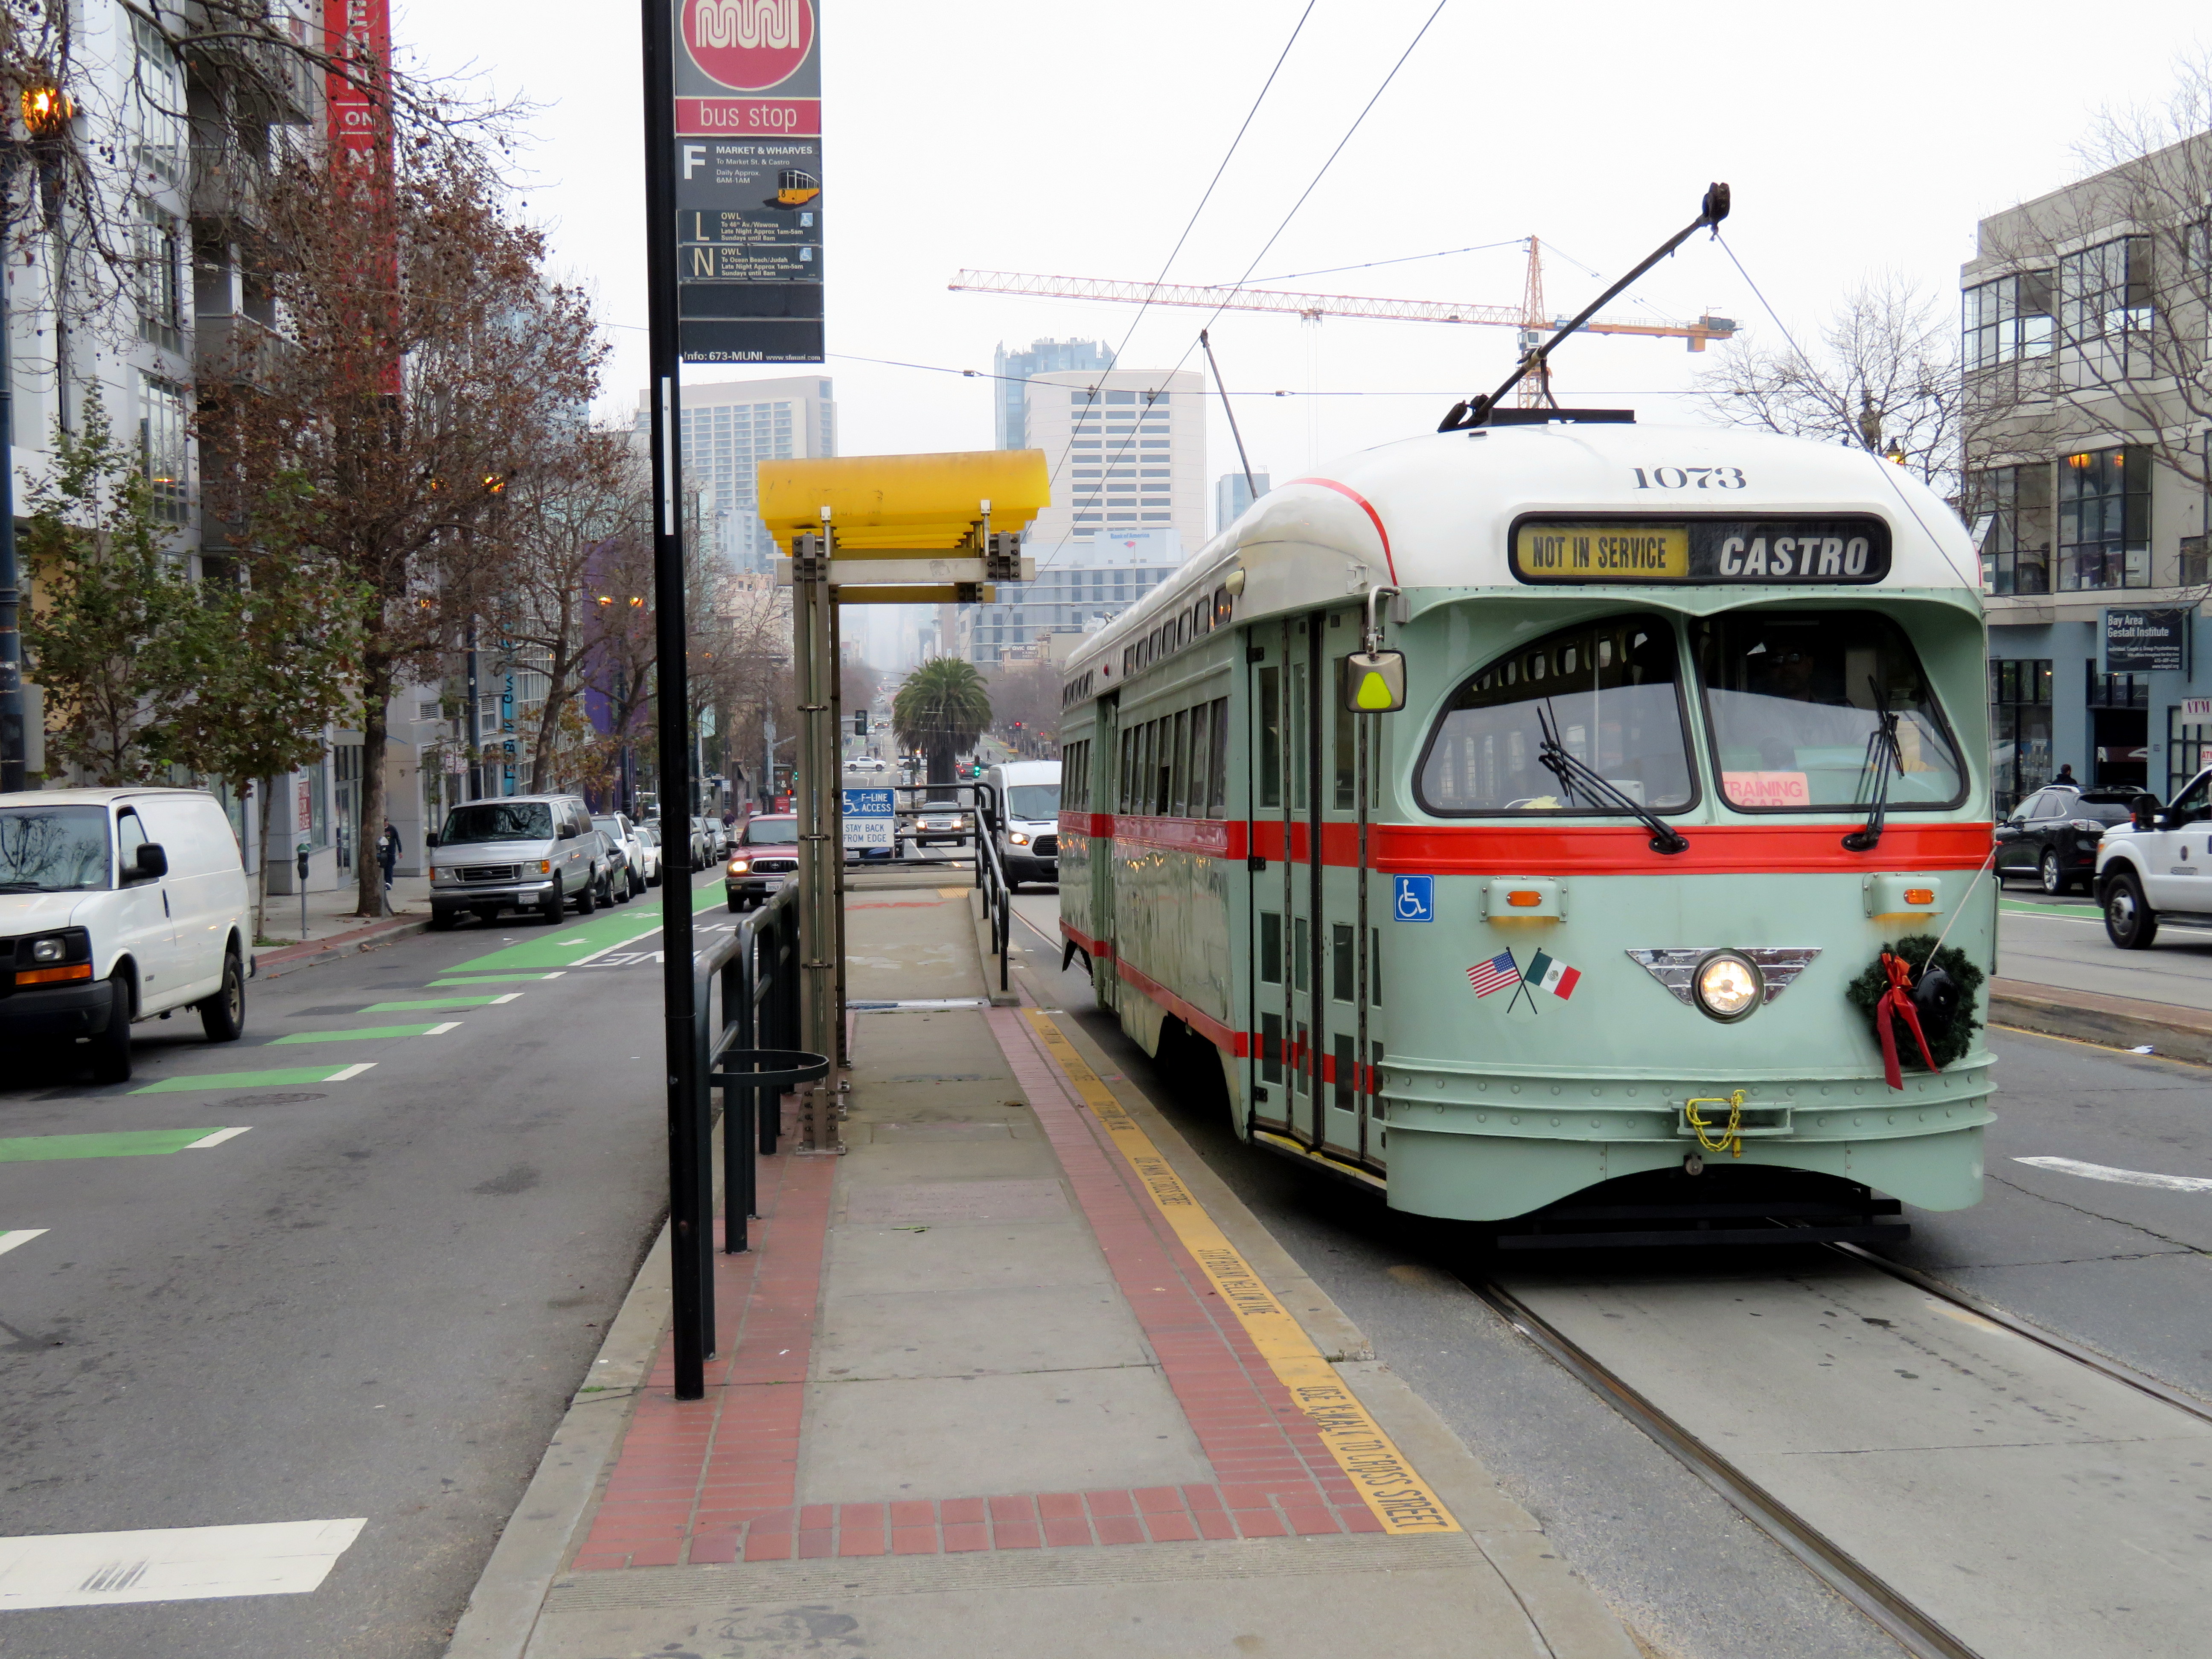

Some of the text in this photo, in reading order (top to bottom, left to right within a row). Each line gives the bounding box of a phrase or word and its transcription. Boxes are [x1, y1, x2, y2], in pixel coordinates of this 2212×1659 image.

[700, 101, 797, 133] bus stop
[716, 146, 755, 154] MARKET
[767, 146, 812, 154] WHARVES
[684, 145, 706, 180] F
[696, 212, 710, 241] L
[694, 248, 714, 276] N
[709, 352, 763, 361] 673-MUNI
[1628, 467, 1746, 489] 1073
[1533, 536, 1666, 568] NOT IN SERVICE
[1719, 537, 1869, 576] CASTRO
[2108, 615, 2143, 628] Bay Area
[2108, 627, 2169, 637] Gestalt Institute
[861, 793, 888, 802] F-LINE
[862, 803, 891, 812] ACCESS
[845, 824, 884, 832] STAY BACK
[843, 834, 864, 842] FROM
[1297, 1386, 1449, 1528] USE X-WALK TO CROSS STREET
